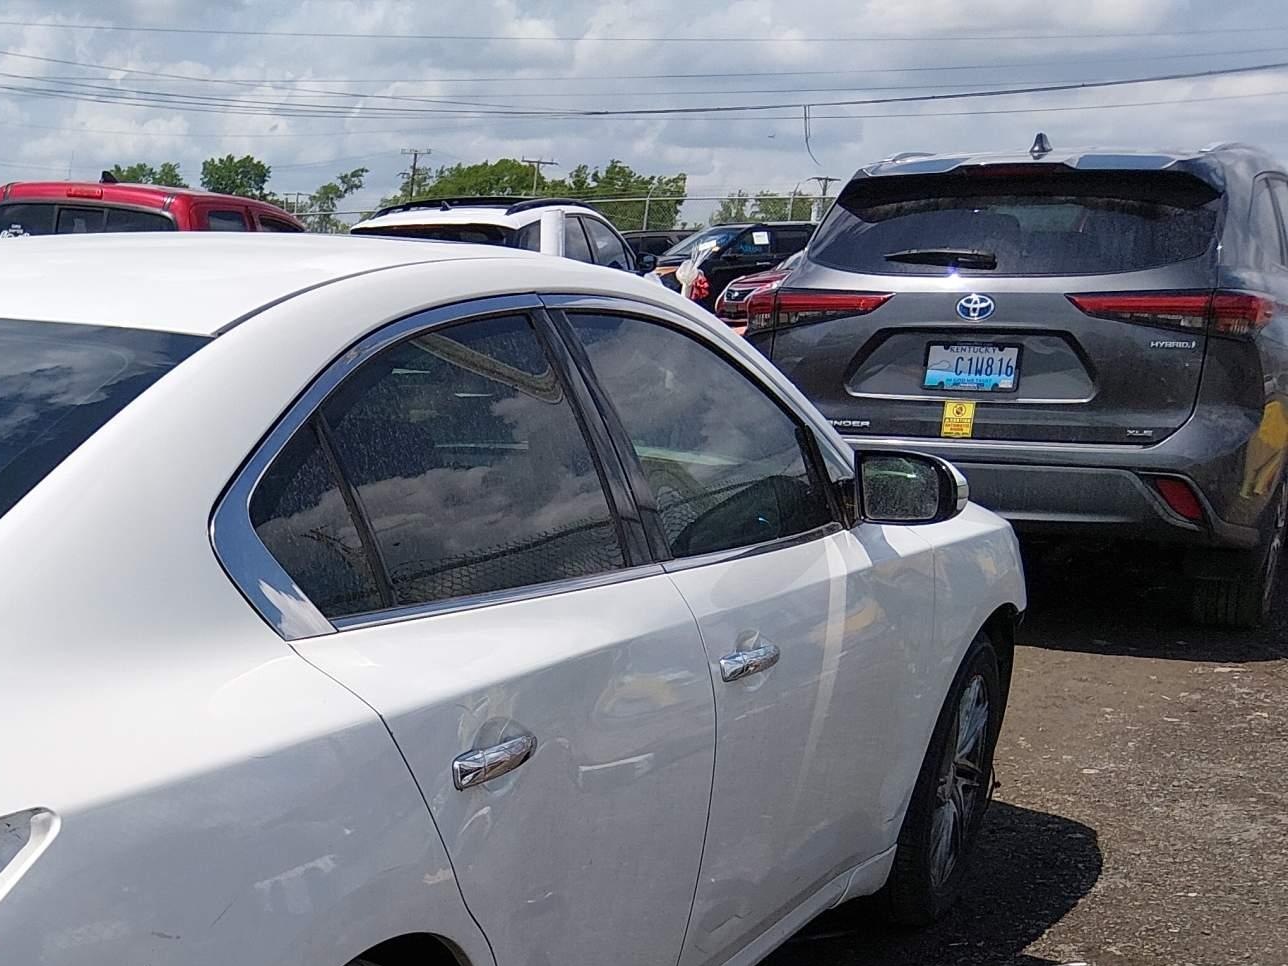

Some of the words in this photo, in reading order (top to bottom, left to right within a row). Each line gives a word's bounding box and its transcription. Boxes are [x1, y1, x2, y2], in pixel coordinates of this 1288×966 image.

[1150, 341, 1189, 349] HYBRID
[950, 346, 996, 354] KENTUCKY
[954, 356, 1014, 378] C1W816
